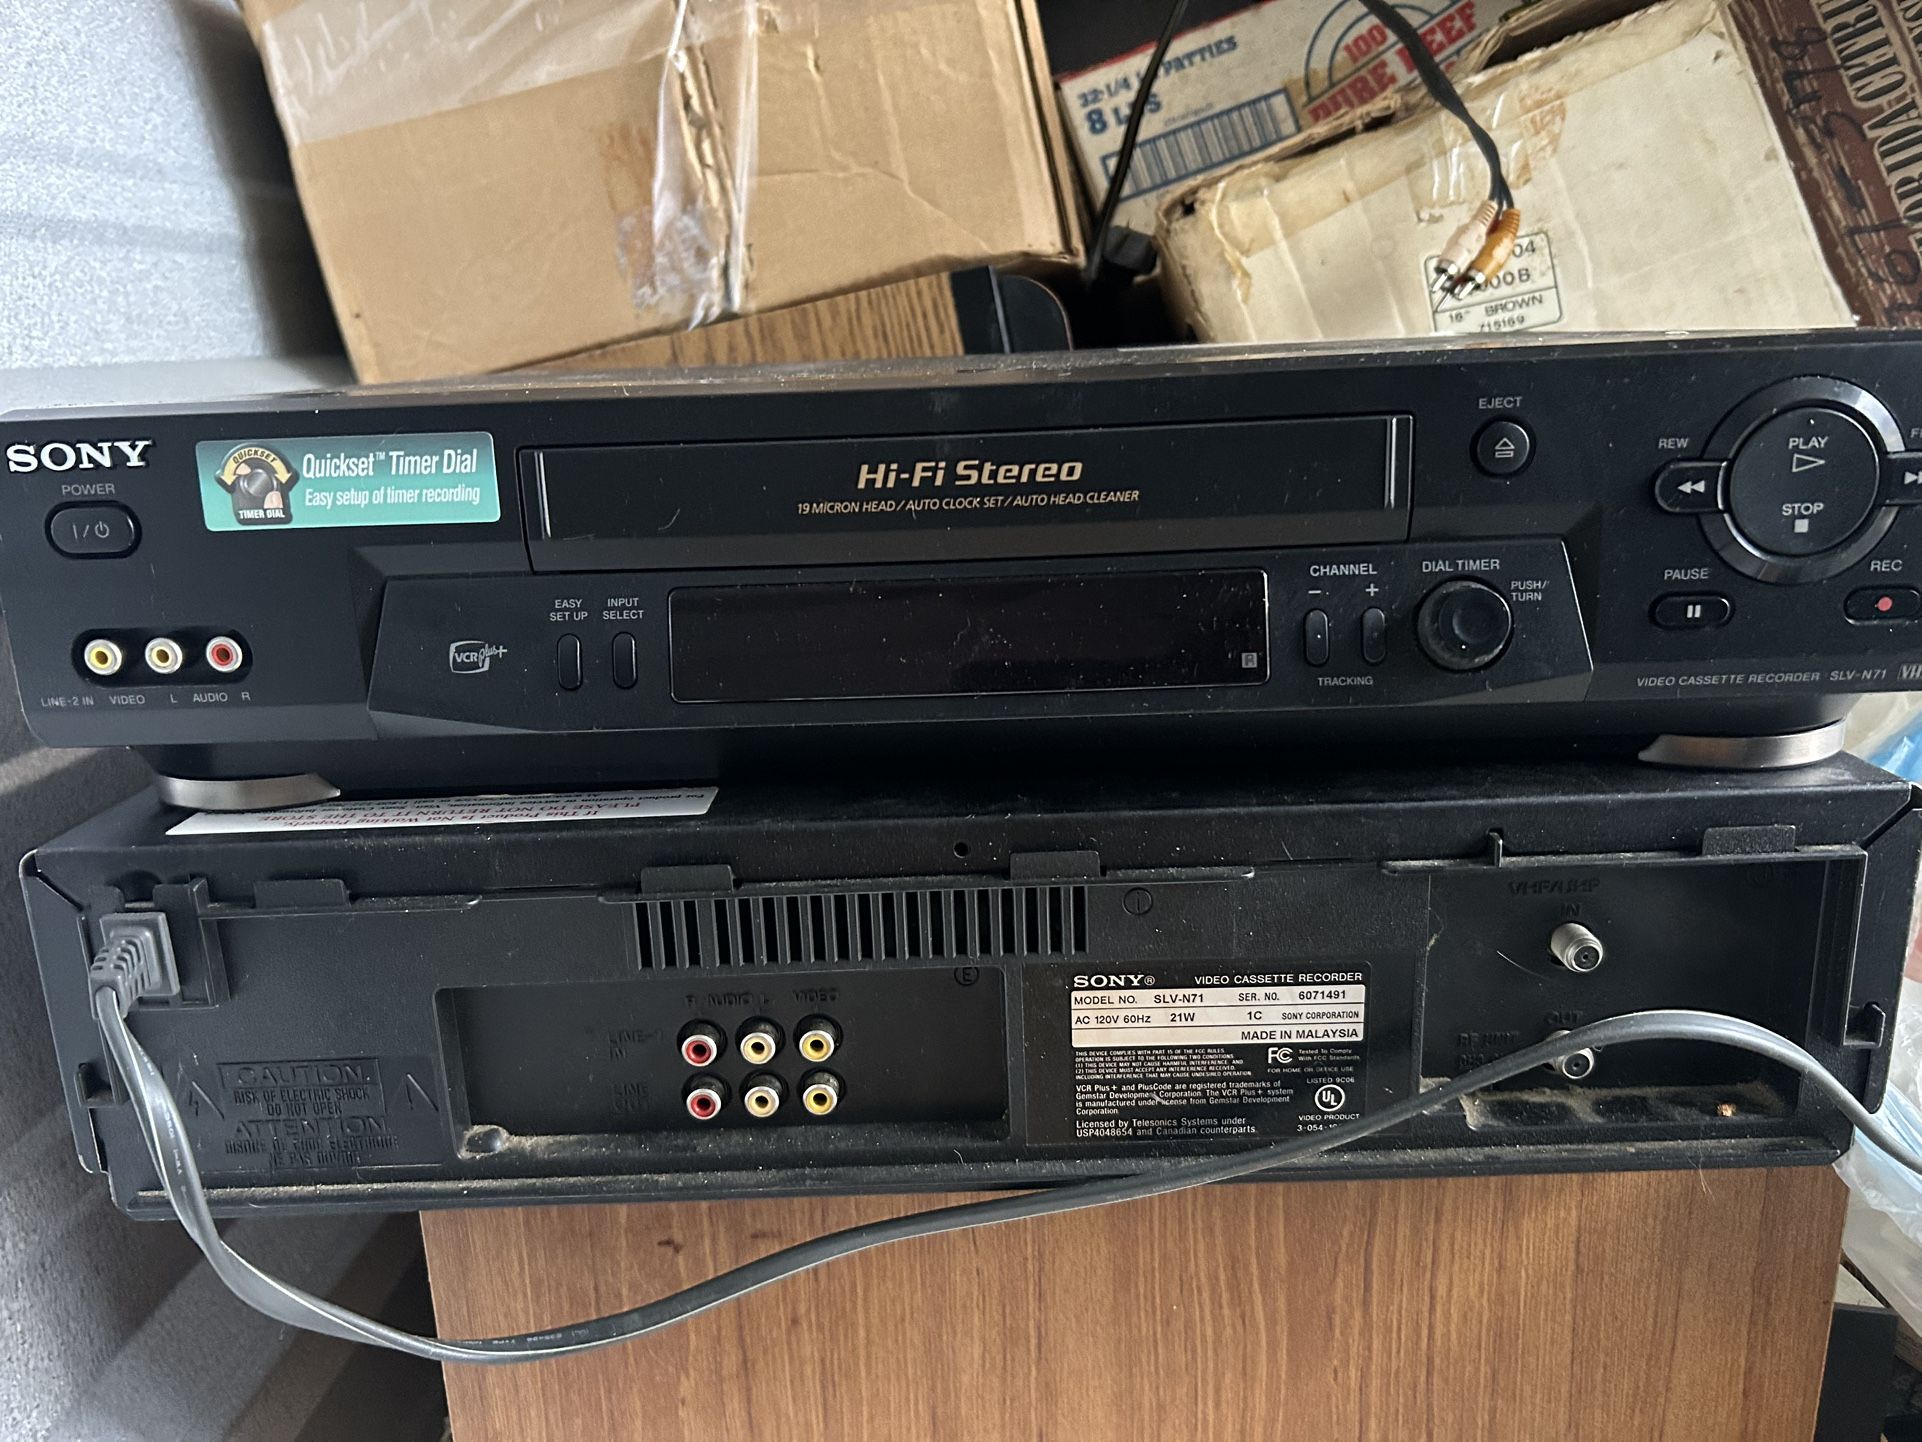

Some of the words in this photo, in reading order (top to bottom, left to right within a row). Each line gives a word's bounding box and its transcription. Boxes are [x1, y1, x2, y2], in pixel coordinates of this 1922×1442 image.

[1343, 24, 1388, 65] 100
[1159, 36, 1238, 77] PATTIES
[1086, 107, 1108, 135] 8
[1485, 294, 1543, 317] BROWN
[1478, 396, 1523, 409] EJECT
[1658, 437, 1690, 450] REW
[1788, 436, 1829, 450] PLAY
[6, 440, 152, 473] SONY
[232, 449, 278, 464] QUICKSET
[389, 451, 439, 476] Timer
[442, 448, 478, 474] Dial
[857, 461, 946, 489] Hi-Fi
[955, 460, 1083, 486] Stereo
[62, 483, 116, 496] POWER
[305, 488, 333, 509] Easy
[336, 487, 370, 508] setup
[372, 486, 386, 504] of
[386, 486, 418, 504] timer
[422, 484, 481, 505] recording
[798, 503, 810, 515] 19
[811, 501, 860, 514] MICRON
[942, 498, 980, 509] CLOCK
[1049, 492, 1084, 505] HEAD
[1086, 490, 1140, 503] CLEANER
[1782, 502, 1825, 516] STOP
[238, 509, 265, 519] TIMER
[266, 508, 285, 518] DIAL
[1309, 563, 1378, 577] CHANNEL
[1422, 561, 1453, 573] DIAL
[1456, 559, 1500, 571] TIMER
[1870, 559, 1903, 572] REC
[1663, 568, 1710, 581] PAUSE
[607, 598, 639, 607] INPUT
[1511, 591, 1542, 602] TURN
[554, 599, 583, 609] EASY
[549, 612, 570, 622] SET
[573, 611, 588, 621] UP
[602, 610, 644, 620] SELECT
[454, 652, 478, 663] VCR
[1317, 676, 1374, 687] TRACKING
[1636, 676, 1675, 688] VIDEO
[1678, 674, 1744, 686] CASSETTE
[1747, 671, 1821, 684] RECORDER
[1829, 669, 1887, 682] SLV-N71
[1901, 663, 1922, 680] VH
[82, 696, 95, 706] IN
[109, 695, 146, 705] VIDEO
[170, 694, 178, 703] L
[193, 692, 229, 703] AUDIO
[241, 691, 251, 701] R
[415, 808, 491, 816] RETURN
[572, 802, 641, 810] PLEASE
[356, 816, 419, 825] Working
[480, 812, 540, 820] Product
[1194, 975, 1230, 985] VIDEO
[1233, 974, 1294, 984] CASSETTE
[1298, 972, 1363, 983] RECORDER
[1074, 995, 1114, 1005] MODEL
[1118, 995, 1138, 1004] NO.
[1153, 993, 1204, 1004] SLV-N71
[1238, 992, 1261, 1002] SER.
[1264, 992, 1280, 1001] NO.
[1298, 990, 1346, 1000] 6071491
[1074, 1016, 1091, 1025] AC
[1094, 1015, 1119, 1024] 120V
[1123, 1014, 1151, 1024] 60Hz
[1170, 1012, 1195, 1022] 21W
[1247, 1011, 1263, 1021] 1C
[1281, 1012, 1303, 1020] SONY
[1305, 1010, 1359, 1020] CORPORATION
[1241, 1031, 1277, 1041] MADE
[1280, 1030, 1292, 1040] IN
[1295, 1028, 1359, 1039] MALAYSIA
[237, 1063, 365, 1084] CAUTION
[1075, 1084, 1092, 1092] VCR
[1121, 1083, 1135, 1091] and
[1137, 1083, 1172, 1091] PlusCode
[1189, 1081, 1227, 1090] registered
[1229, 1080, 1271, 1088] trademarks
[233, 1089, 260, 1104] RISK
[263, 1088, 276, 1102] OF
[280, 1088, 331, 1102] ELECTRIC
[335, 1087, 370, 1100] SHOCK
[1075, 1092, 1107, 1100] Gemstar
[1206, 1089, 1220, 1097] The
[1267, 1088, 1294, 1096] system
[1322, 1090, 1338, 1106] UL
[1075, 1100, 1083, 1108] is
[1085, 1099, 1136, 1107] manufactured
[1189, 1097, 1207, 1105] from
[1242, 1095, 1290, 1104] Development
[266, 1103, 282, 1116] DO
[286, 1102, 308, 1117] NOT
[313, 1101, 343, 1114] OPEN
[236, 1116, 387, 1138] ATTENTION
[1076, 1120, 1115, 1129] Licensed
[1118, 1120, 1129, 1130] by
[1131, 1119, 1177, 1127] Telesonics
[1181, 1118, 1218, 1127] Systems
[1221, 1116, 1246, 1125] under
[1076, 1127, 1133, 1137] USP4048654
[1136, 1128, 1153, 1136] and
[1156, 1126, 1197, 1136] Canadian
